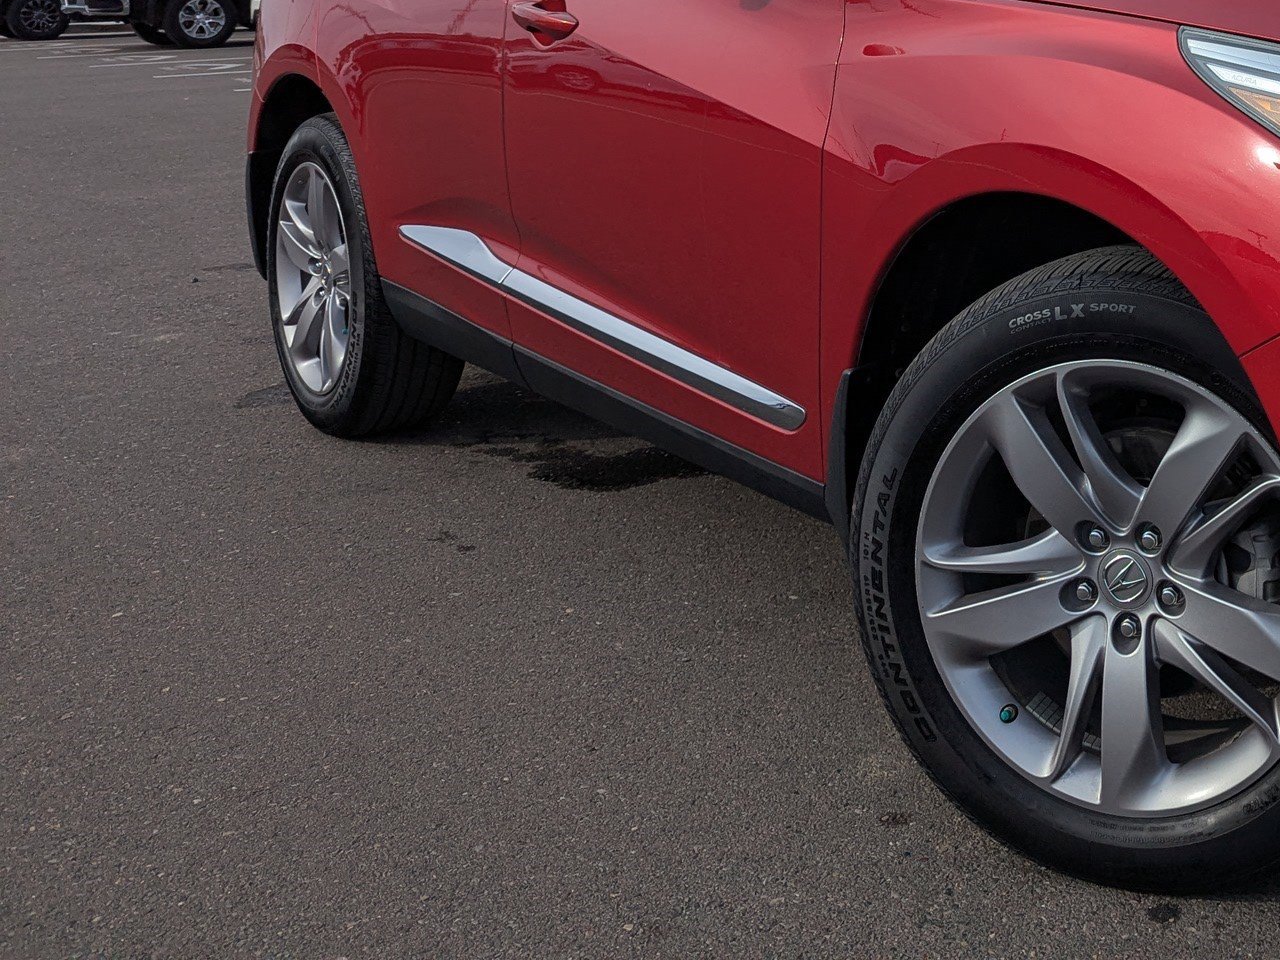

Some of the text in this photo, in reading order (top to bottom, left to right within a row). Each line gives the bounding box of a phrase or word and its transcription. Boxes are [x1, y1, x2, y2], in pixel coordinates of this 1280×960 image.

[1008, 309, 1051, 328] CROSS
[1090, 303, 1136, 314] SPORT
[1010, 319, 1051, 334] CONTACT
[870, 467, 938, 742] CONTINENTAL
